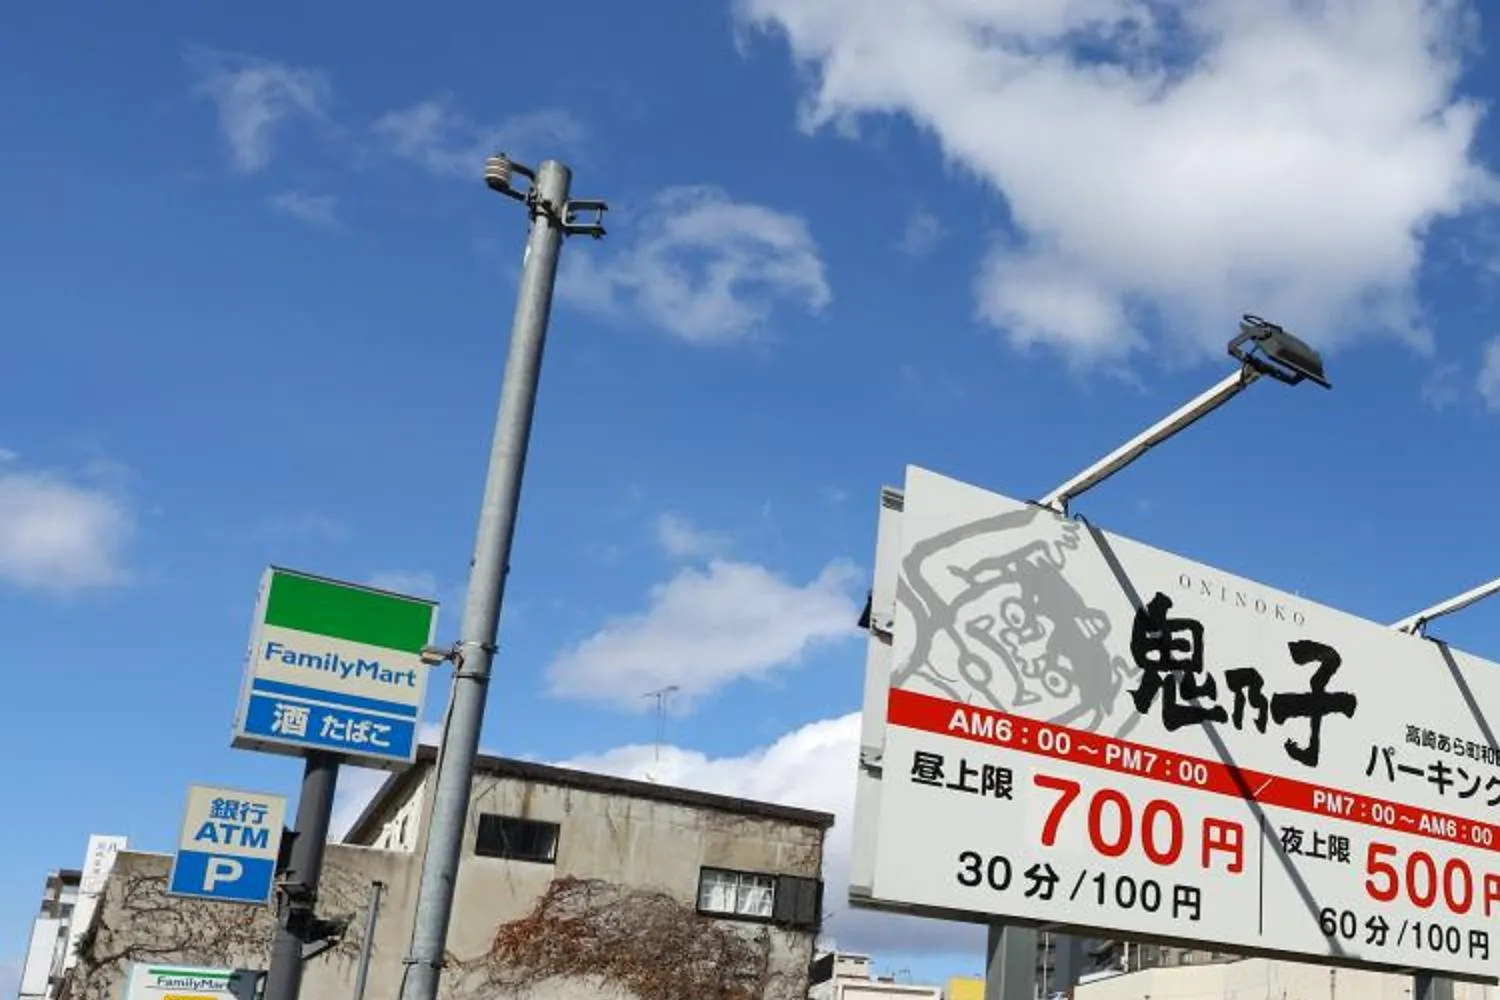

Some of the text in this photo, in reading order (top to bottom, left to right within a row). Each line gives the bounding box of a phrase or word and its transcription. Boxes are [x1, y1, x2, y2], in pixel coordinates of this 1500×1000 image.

[1178, 572, 1307, 627] ONINOKO
[264, 640, 417, 689] FamilyMart
[1128, 590, 1357, 768] 鬼乃子
[271, 702, 392, 748] 酒 たばこ
[210, 797, 269, 825] 銀行
[909, 750, 1245, 875] 昼上限 700円
[192, 821, 270, 850] ATM
[1279, 825, 1352, 864] 夜上限
[202, 857, 244, 892] P
[157, 975, 225, 992] FamilyMar
